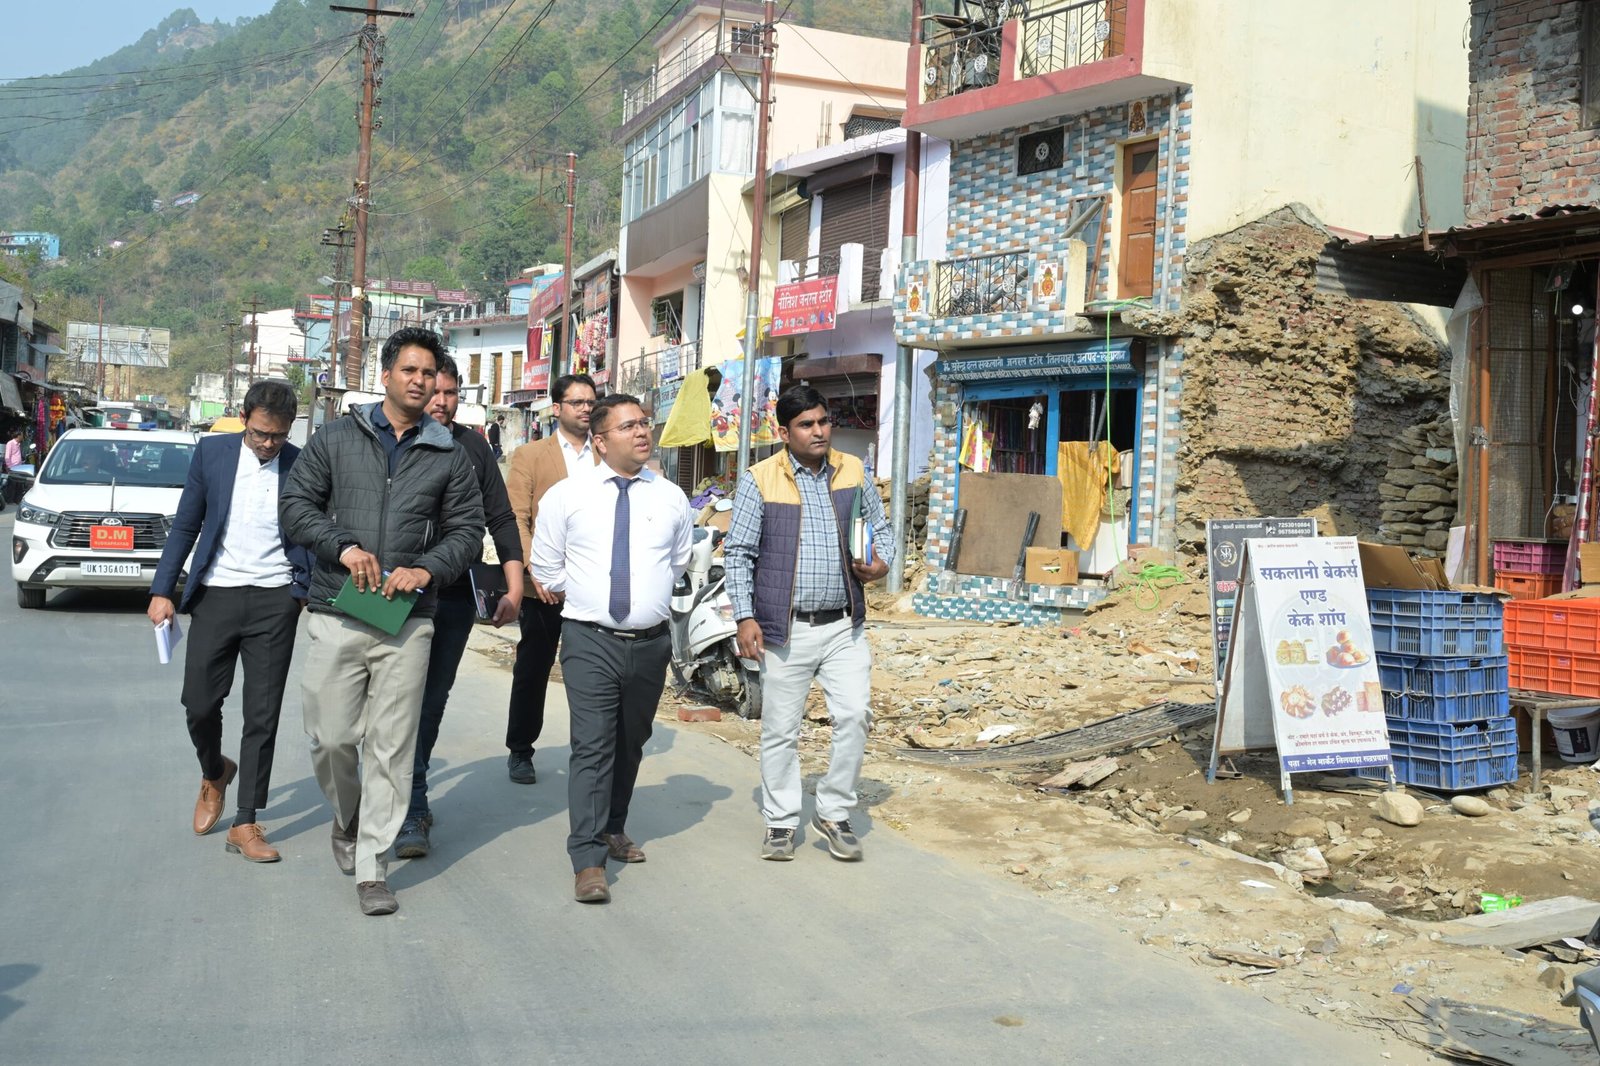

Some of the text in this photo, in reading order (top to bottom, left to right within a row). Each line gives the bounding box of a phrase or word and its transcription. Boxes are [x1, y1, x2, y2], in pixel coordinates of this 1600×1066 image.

[799, 292, 818, 306] जनरल
[1006, 357, 1027, 366] जनरल
[1028, 354, 1043, 366] स्टोर
[96, 529, 128, 540] D.M
[86, 564, 139, 574] UK13GA0111
[1260, 559, 1358, 580] सकलानी बेकर्स
[1300, 590, 1328, 605] एण्ड
[1288, 608, 1346, 627] केक शॉप
[1288, 760, 1300, 769] पता
[1318, 755, 1335, 764] मार्केट
